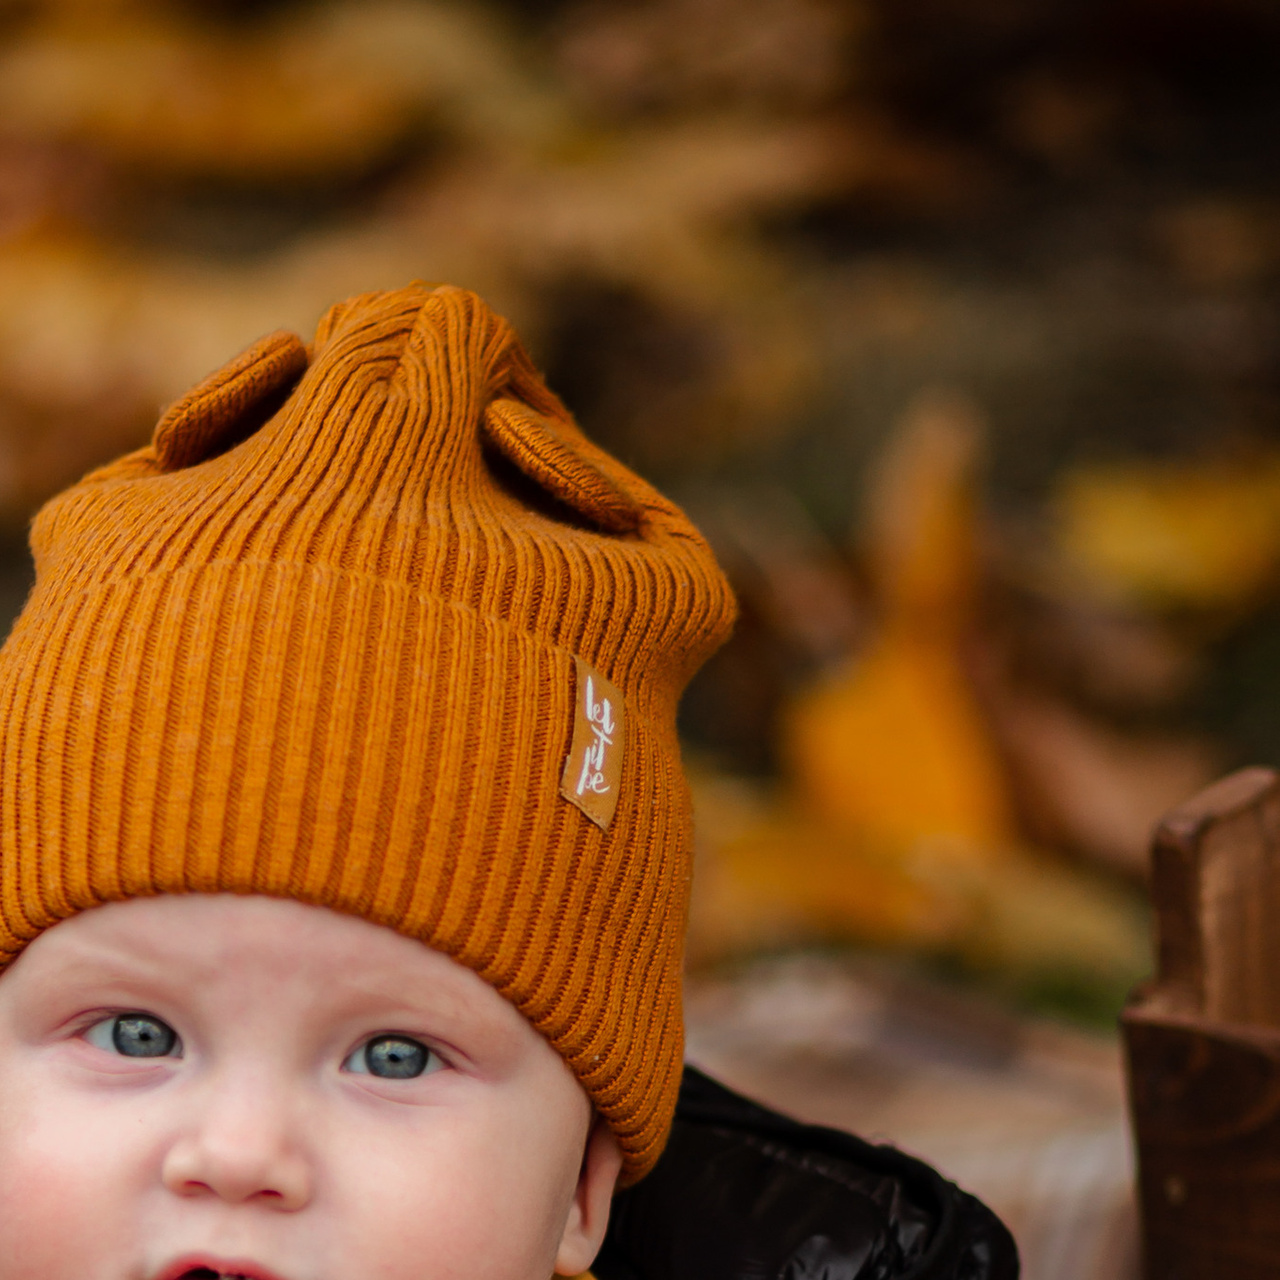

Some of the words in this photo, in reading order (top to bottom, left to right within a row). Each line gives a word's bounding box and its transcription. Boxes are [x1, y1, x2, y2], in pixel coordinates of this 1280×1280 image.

[587, 675, 615, 735] let
[577, 746, 610, 796] be
[590, 724, 613, 771] it
